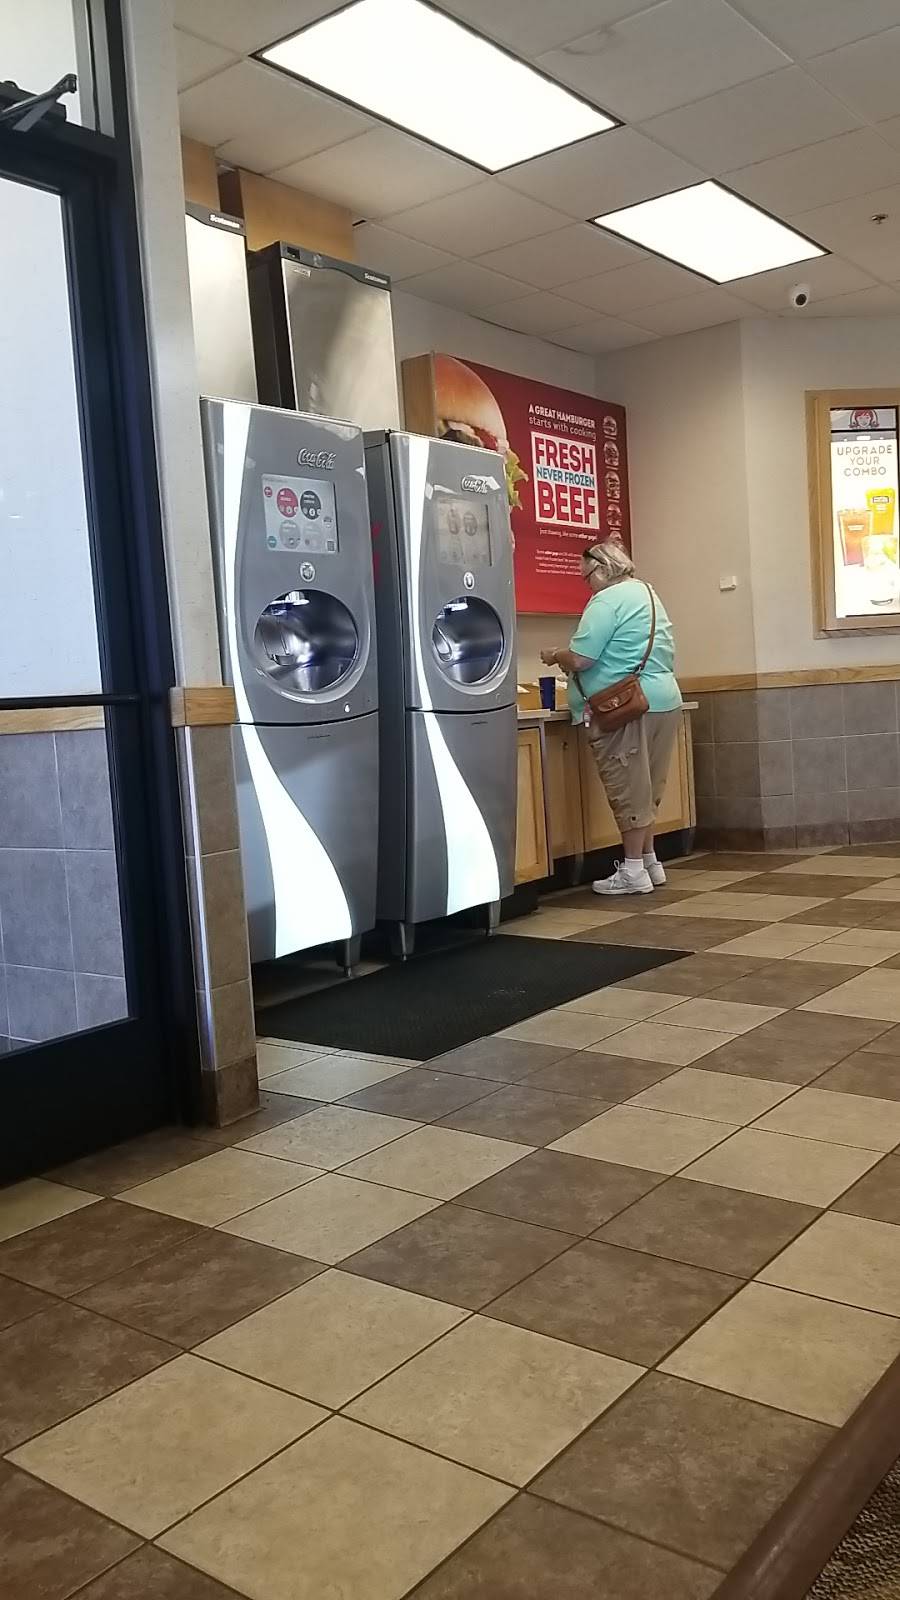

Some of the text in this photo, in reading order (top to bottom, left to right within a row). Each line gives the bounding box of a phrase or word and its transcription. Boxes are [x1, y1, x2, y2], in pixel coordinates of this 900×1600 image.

[528, 404, 596, 429] A GREAT HAMBURGER
[528, 416, 597, 442] starts with cooking
[534, 437, 594, 475] FRESH
[837, 445, 893, 456] UPGRADE
[849, 457, 880, 466] YOUR
[536, 466, 595, 488] NEVER FROZEN
[843, 466, 887, 476] COMBO
[537, 481, 596, 525] BEEF
